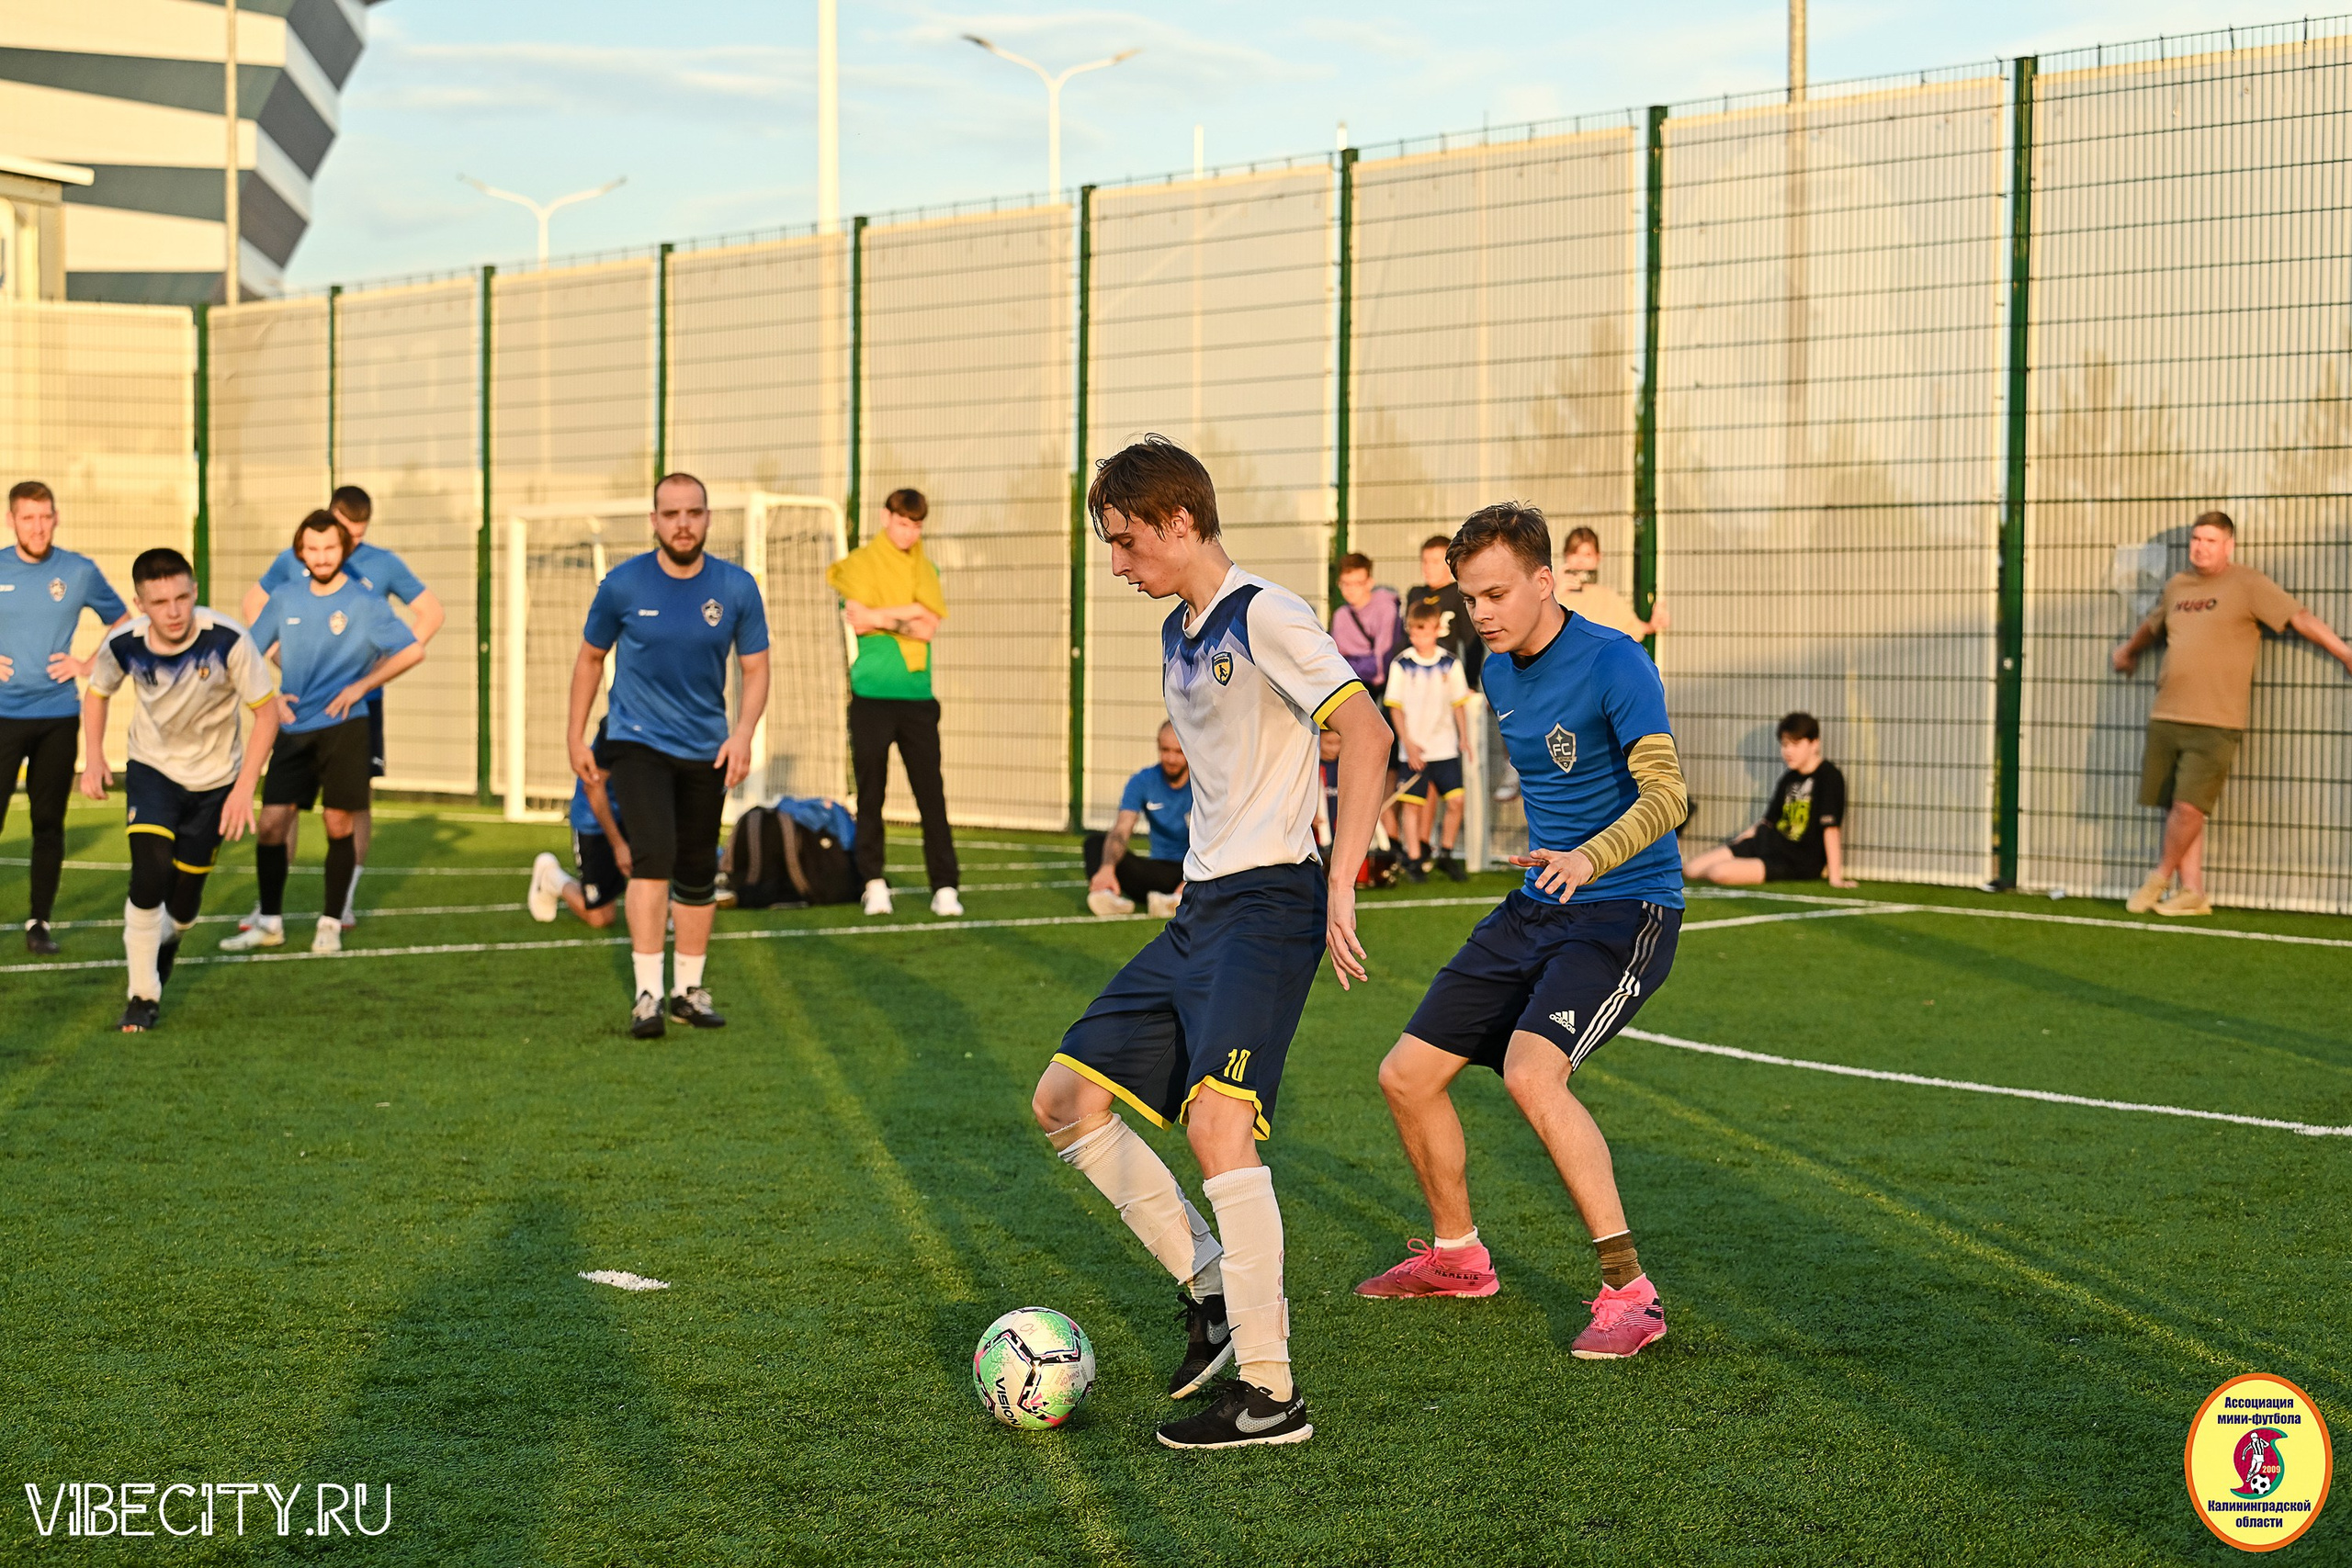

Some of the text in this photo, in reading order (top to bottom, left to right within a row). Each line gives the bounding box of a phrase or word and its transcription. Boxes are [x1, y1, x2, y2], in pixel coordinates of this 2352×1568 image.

[1553, 743, 1571, 757] FC
[1549, 1013, 1577, 1035] adidas
[1223, 1048, 1251, 1083] 10
[995, 1376, 1022, 1426] VISION
